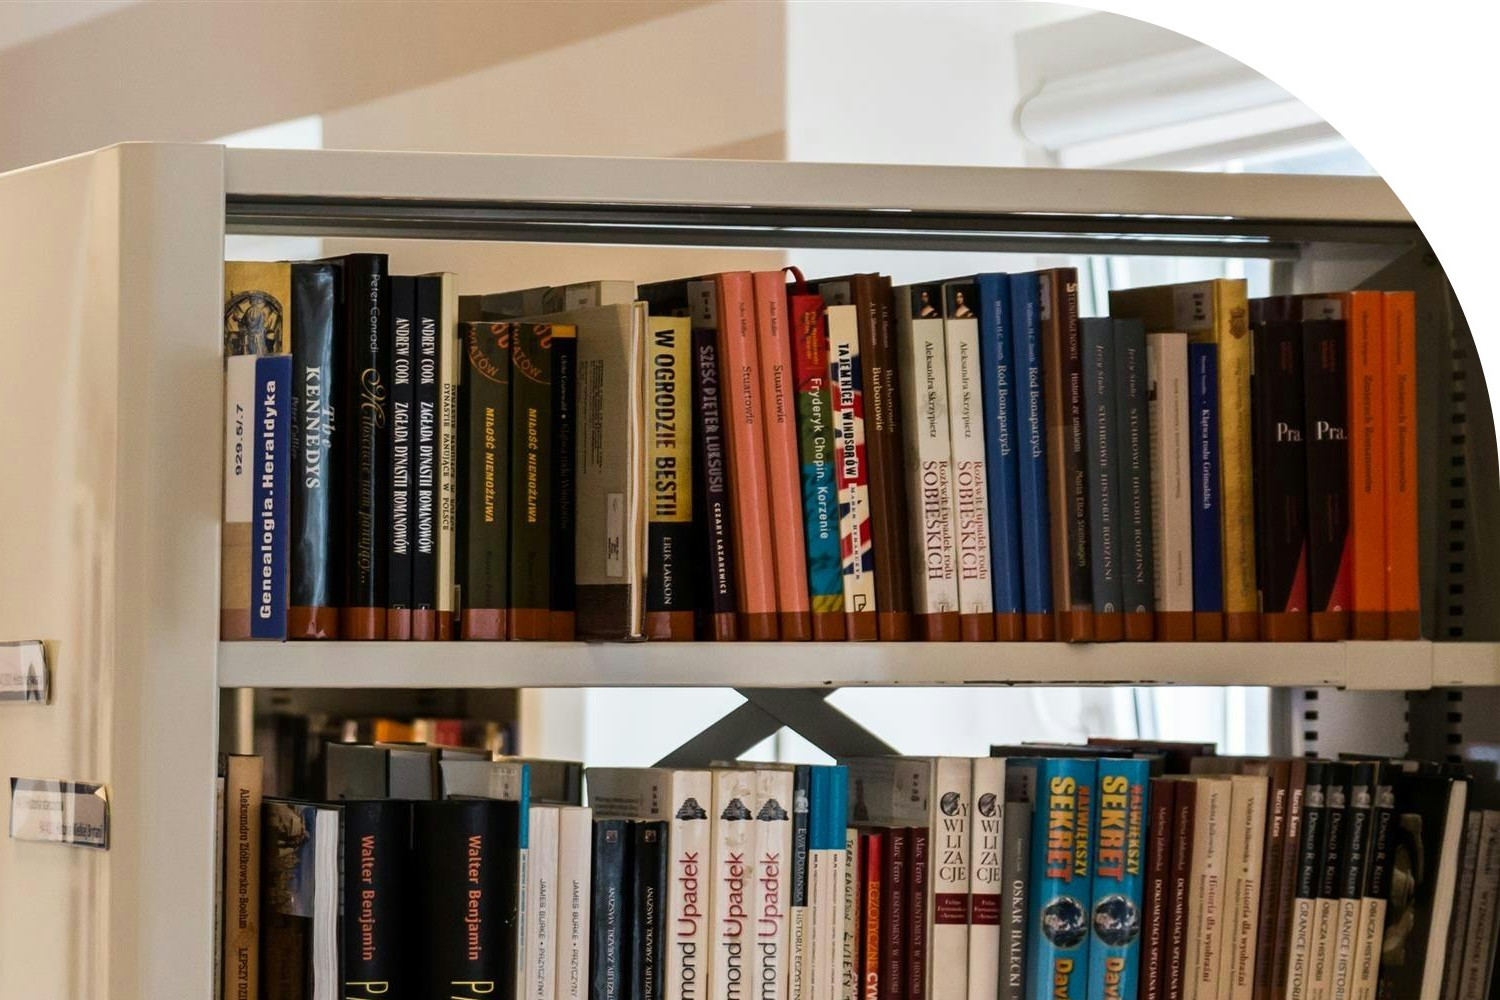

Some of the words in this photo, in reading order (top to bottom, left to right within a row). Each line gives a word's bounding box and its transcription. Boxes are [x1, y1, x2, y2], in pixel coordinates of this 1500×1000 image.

[370, 273, 381, 303] Peter
[370, 306, 381, 354] Conradi
[394, 317, 409, 356] ANDREW
[420, 317, 435, 356] ANDREW
[654, 329, 675, 349] W
[394, 358, 409, 385] COOK
[420, 358, 435, 385] COOK
[741, 365, 756, 425] Stuartowie
[772, 364, 787, 424] Stuartowie
[838, 343, 854, 406] TAJEMNICE
[996, 365, 1009, 386] Ród
[1028, 366, 1039, 388] Ród
[394, 401, 410, 443] ZAGŁADA
[420, 401, 436, 443] ZAGŁADA
[654, 353, 677, 450] OGRODZIE
[808, 378, 824, 433] Fryderyk
[872, 366, 885, 431] Burbonowie
[305, 366, 321, 490] KENNEDYS
[321, 405, 336, 449] The
[484, 407, 498, 450] MIŁOŚĆ
[527, 407, 539, 450] MIŁOŚĆ
[841, 410, 858, 476] WINDSORÓW
[996, 388, 1012, 457] Bonapartych
[1028, 390, 1043, 458] Bonapartych
[393, 446, 410, 488] DYNASTII
[419, 446, 436, 488] DYNASTII
[484, 452, 498, 523] NIEMOŻLIWA
[527, 453, 539, 523] NIEMOŻLIWA
[655, 455, 678, 516] BESTII
[259, 380, 277, 619] Genealogia.Heraldyka
[393, 490, 411, 556] ROMANOWÓW
[419, 490, 437, 556] ROMANOWÓW
[815, 486, 831, 540] Korzenie
[923, 460, 943, 581] SOBIESKICH
[957, 460, 978, 581] SOBIESKICH
[663, 536, 673, 561] ERIK
[663, 563, 674, 605] LARSON
[892, 836, 903, 859] Marc
[914, 837, 926, 859] Marc
[943, 819, 964, 833] WI
[946, 835, 962, 849] LI
[981, 820, 1000, 834] WI
[984, 836, 998, 850] LI
[1046, 775, 1077, 883] SEKRET
[1072, 785, 1090, 876] NAJWIĘKSZY
[1097, 775, 1128, 882] SEKRET
[1125, 784, 1144, 875] NAJWIĘKSZY
[361, 835, 375, 884] Walter
[468, 834, 482, 884] Walter
[893, 860, 903, 883] Ferro
[915, 861, 926, 884] Ferro
[939, 866, 967, 883] CJE
[943, 851, 964, 865] ZA
[976, 867, 1001, 884] CJE
[981, 852, 999, 866] ZA
[676, 852, 704, 937] Upadek
[722, 852, 749, 937] Upadek
[758, 852, 784, 937] Upadek
[1011, 879, 1024, 924] OSKAR
[358, 889, 376, 961] Benjamin
[465, 889, 482, 961] Benjamin
[794, 909, 805, 954] HISTORIA
[1295, 901, 1311, 951] GRANICE
[1319, 901, 1332, 940] OBLICZA
[1339, 901, 1355, 951] GRANICE
[1009, 928, 1023, 987] HALECKI
[1291, 953, 1306, 1000] HISTORII
[1315, 941, 1327, 982] HISTORII
[1335, 953, 1350, 1000] HISTORII
